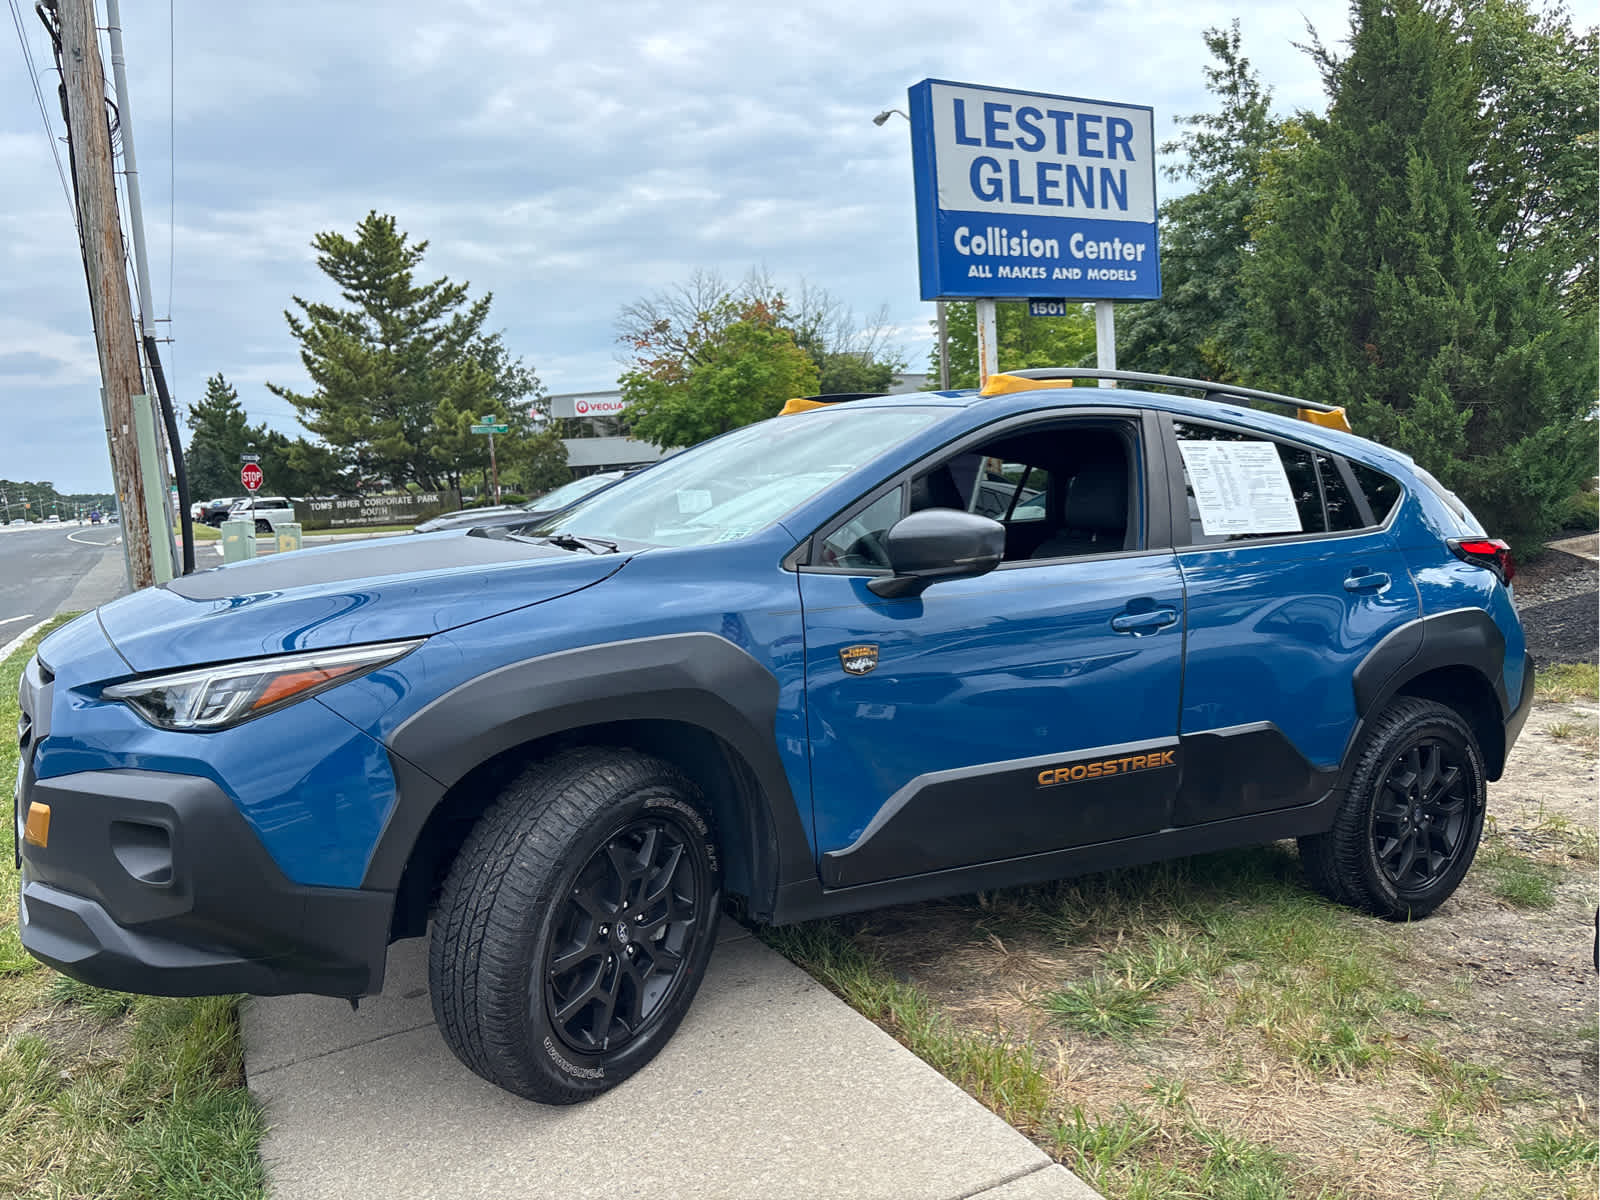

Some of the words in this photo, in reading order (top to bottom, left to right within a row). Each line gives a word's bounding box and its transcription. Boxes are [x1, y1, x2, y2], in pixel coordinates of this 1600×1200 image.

[953, 98, 1136, 162] LESTER
[969, 156, 1129, 211] GLENN
[953, 226, 1060, 259] Collision
[1069, 232, 1146, 262] Center
[967, 265, 993, 278] ALL
[997, 266, 1048, 280] MAKES
[1052, 267, 1082, 280] AND
[1087, 268, 1138, 281] MODELS
[1031, 302, 1065, 315] 1501
[590, 402, 624, 411] VEOLIA
[243, 471, 261, 482] STOP
[310, 501, 332, 511] TOMS
[336, 499, 360, 509] RIVER
[364, 496, 412, 507] CORPORATE
[417, 494, 439, 504] PARK
[361, 506, 388, 517] SOUTH
[1037, 750, 1176, 785] CROSSTREK
